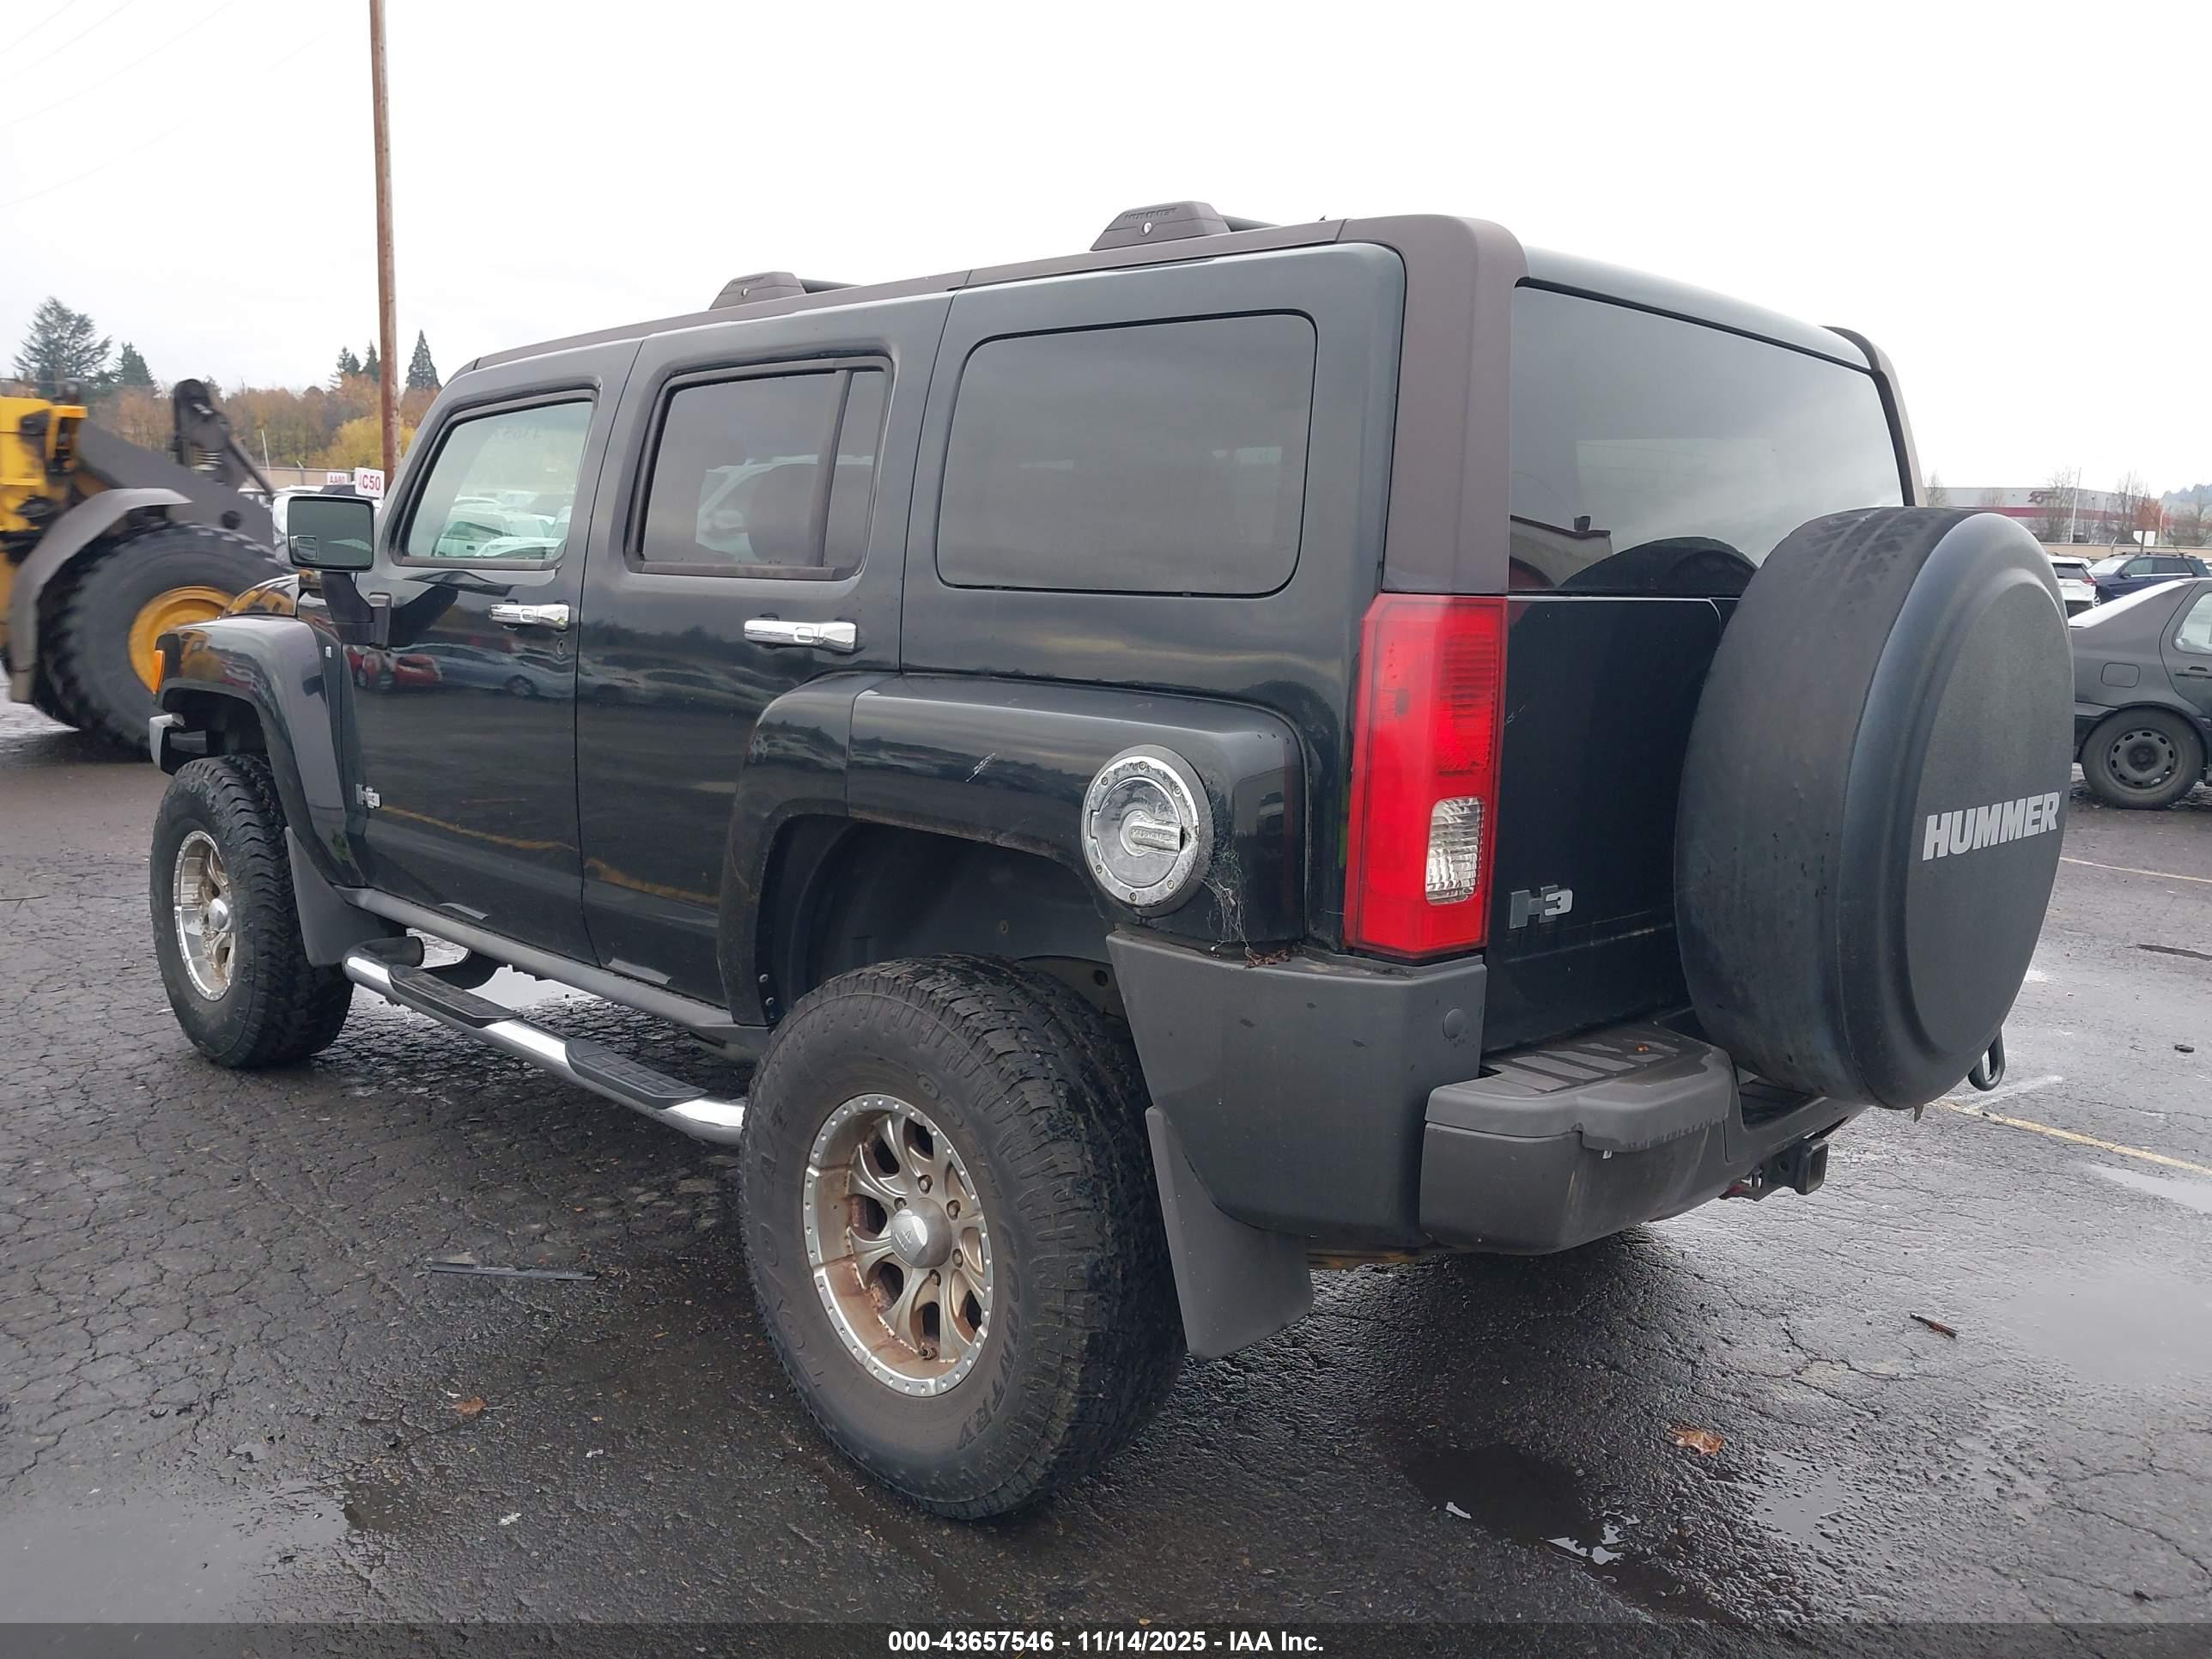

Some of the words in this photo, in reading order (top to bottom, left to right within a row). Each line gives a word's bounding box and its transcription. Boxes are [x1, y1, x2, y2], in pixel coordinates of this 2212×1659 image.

[1923, 791, 2061, 861] HUMMER
[1510, 884, 1573, 929] H3
[956, 1221, 1020, 1451] COUNTRY
